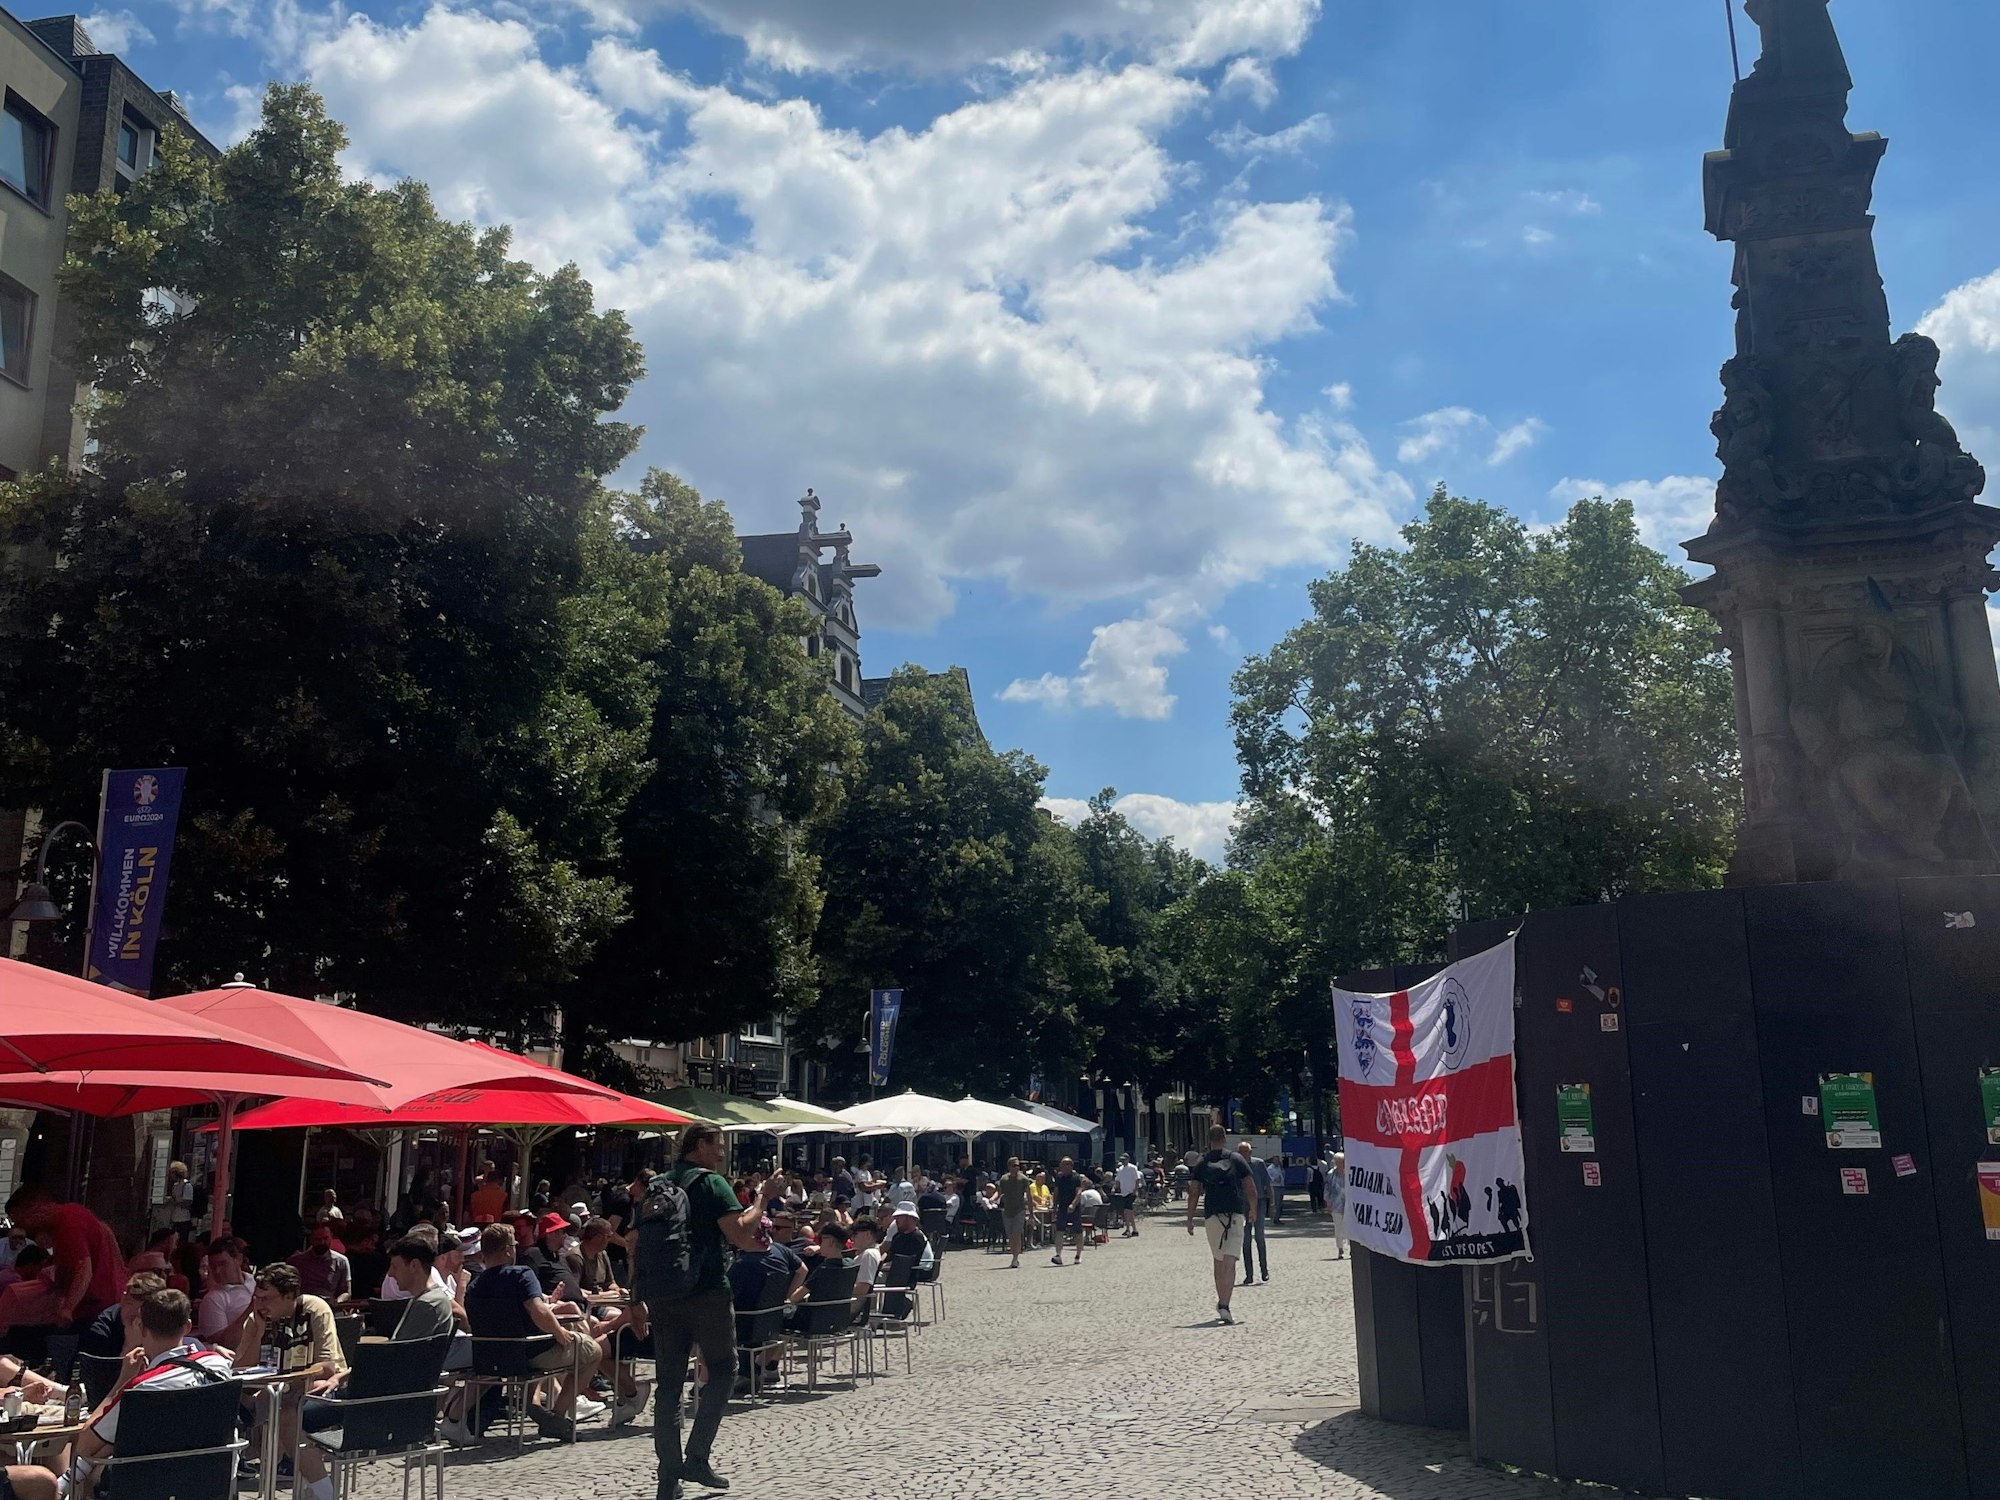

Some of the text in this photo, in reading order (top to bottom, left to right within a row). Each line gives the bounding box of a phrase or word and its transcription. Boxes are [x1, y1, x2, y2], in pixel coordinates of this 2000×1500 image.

[107, 848, 135, 959] WILLKOMMEN
[129, 847, 158, 926] KÖLN
[120, 930, 142, 960] IN
